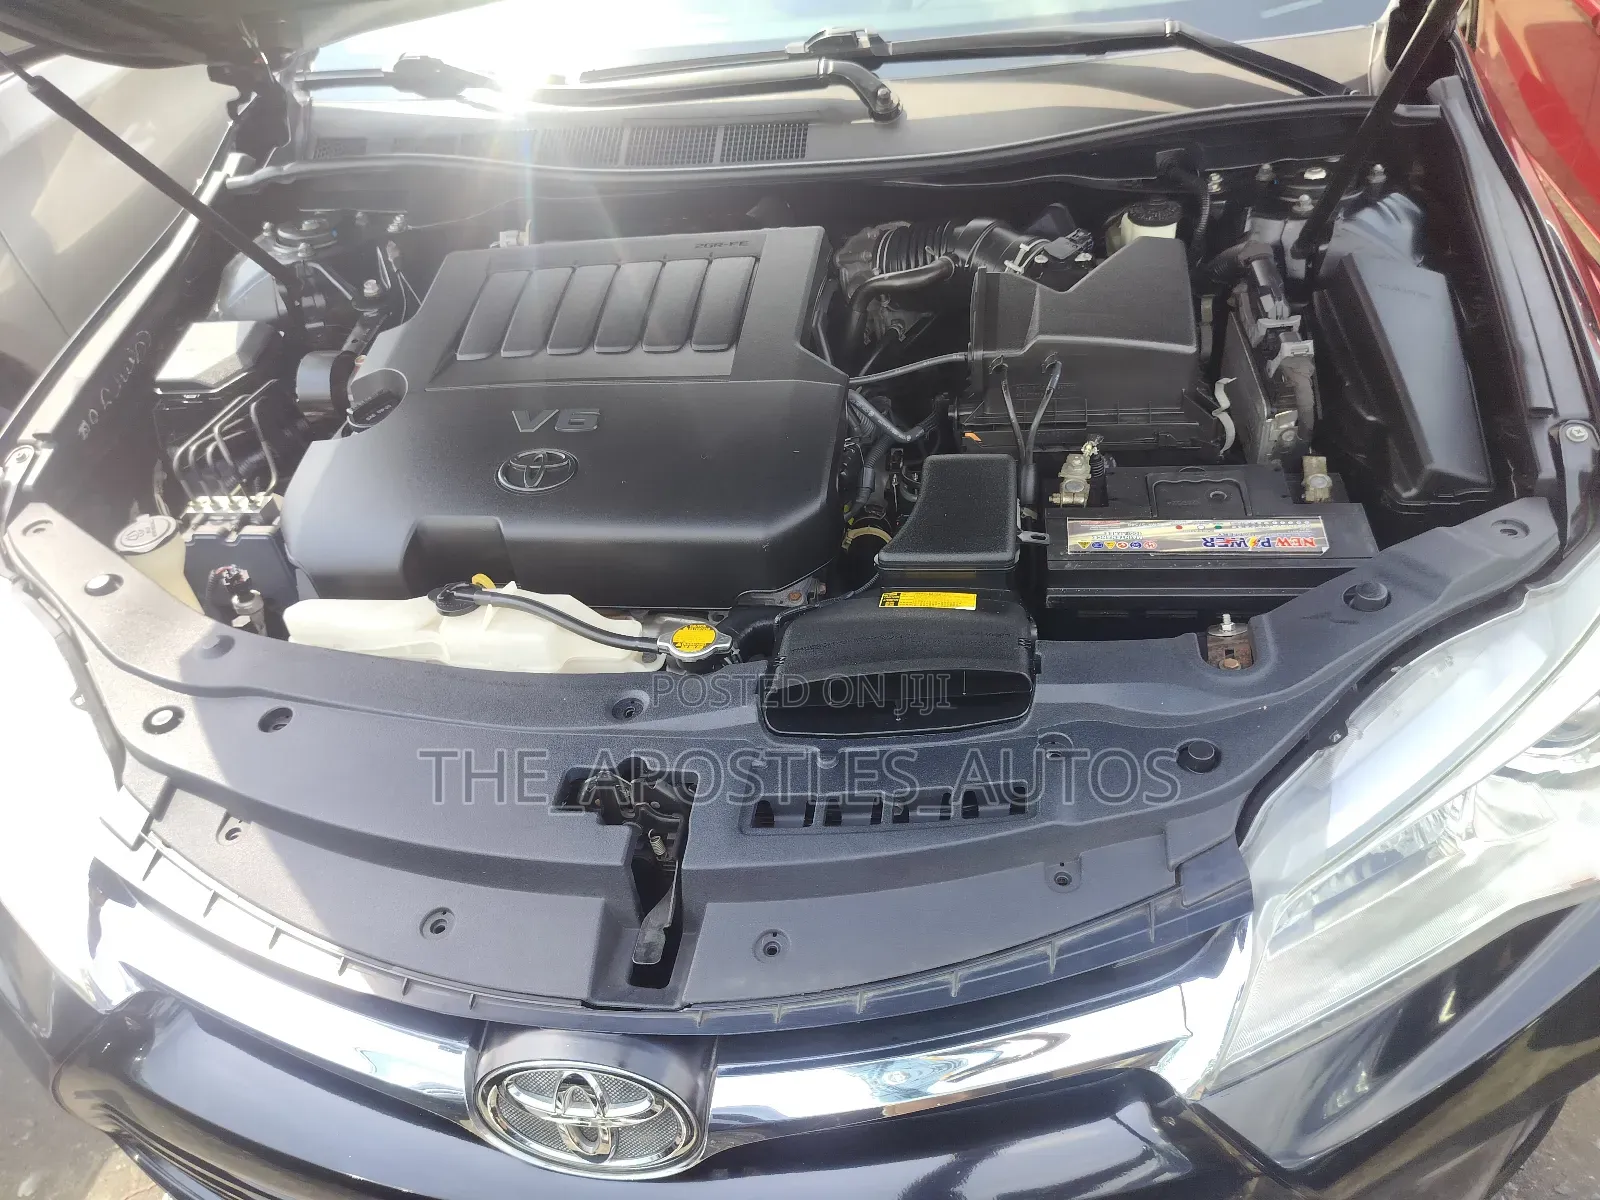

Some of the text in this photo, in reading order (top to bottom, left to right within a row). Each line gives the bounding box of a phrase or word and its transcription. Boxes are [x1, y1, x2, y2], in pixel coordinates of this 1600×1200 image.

[511, 408, 601, 433] V6
[1201, 537, 1316, 549] NEW POWER
